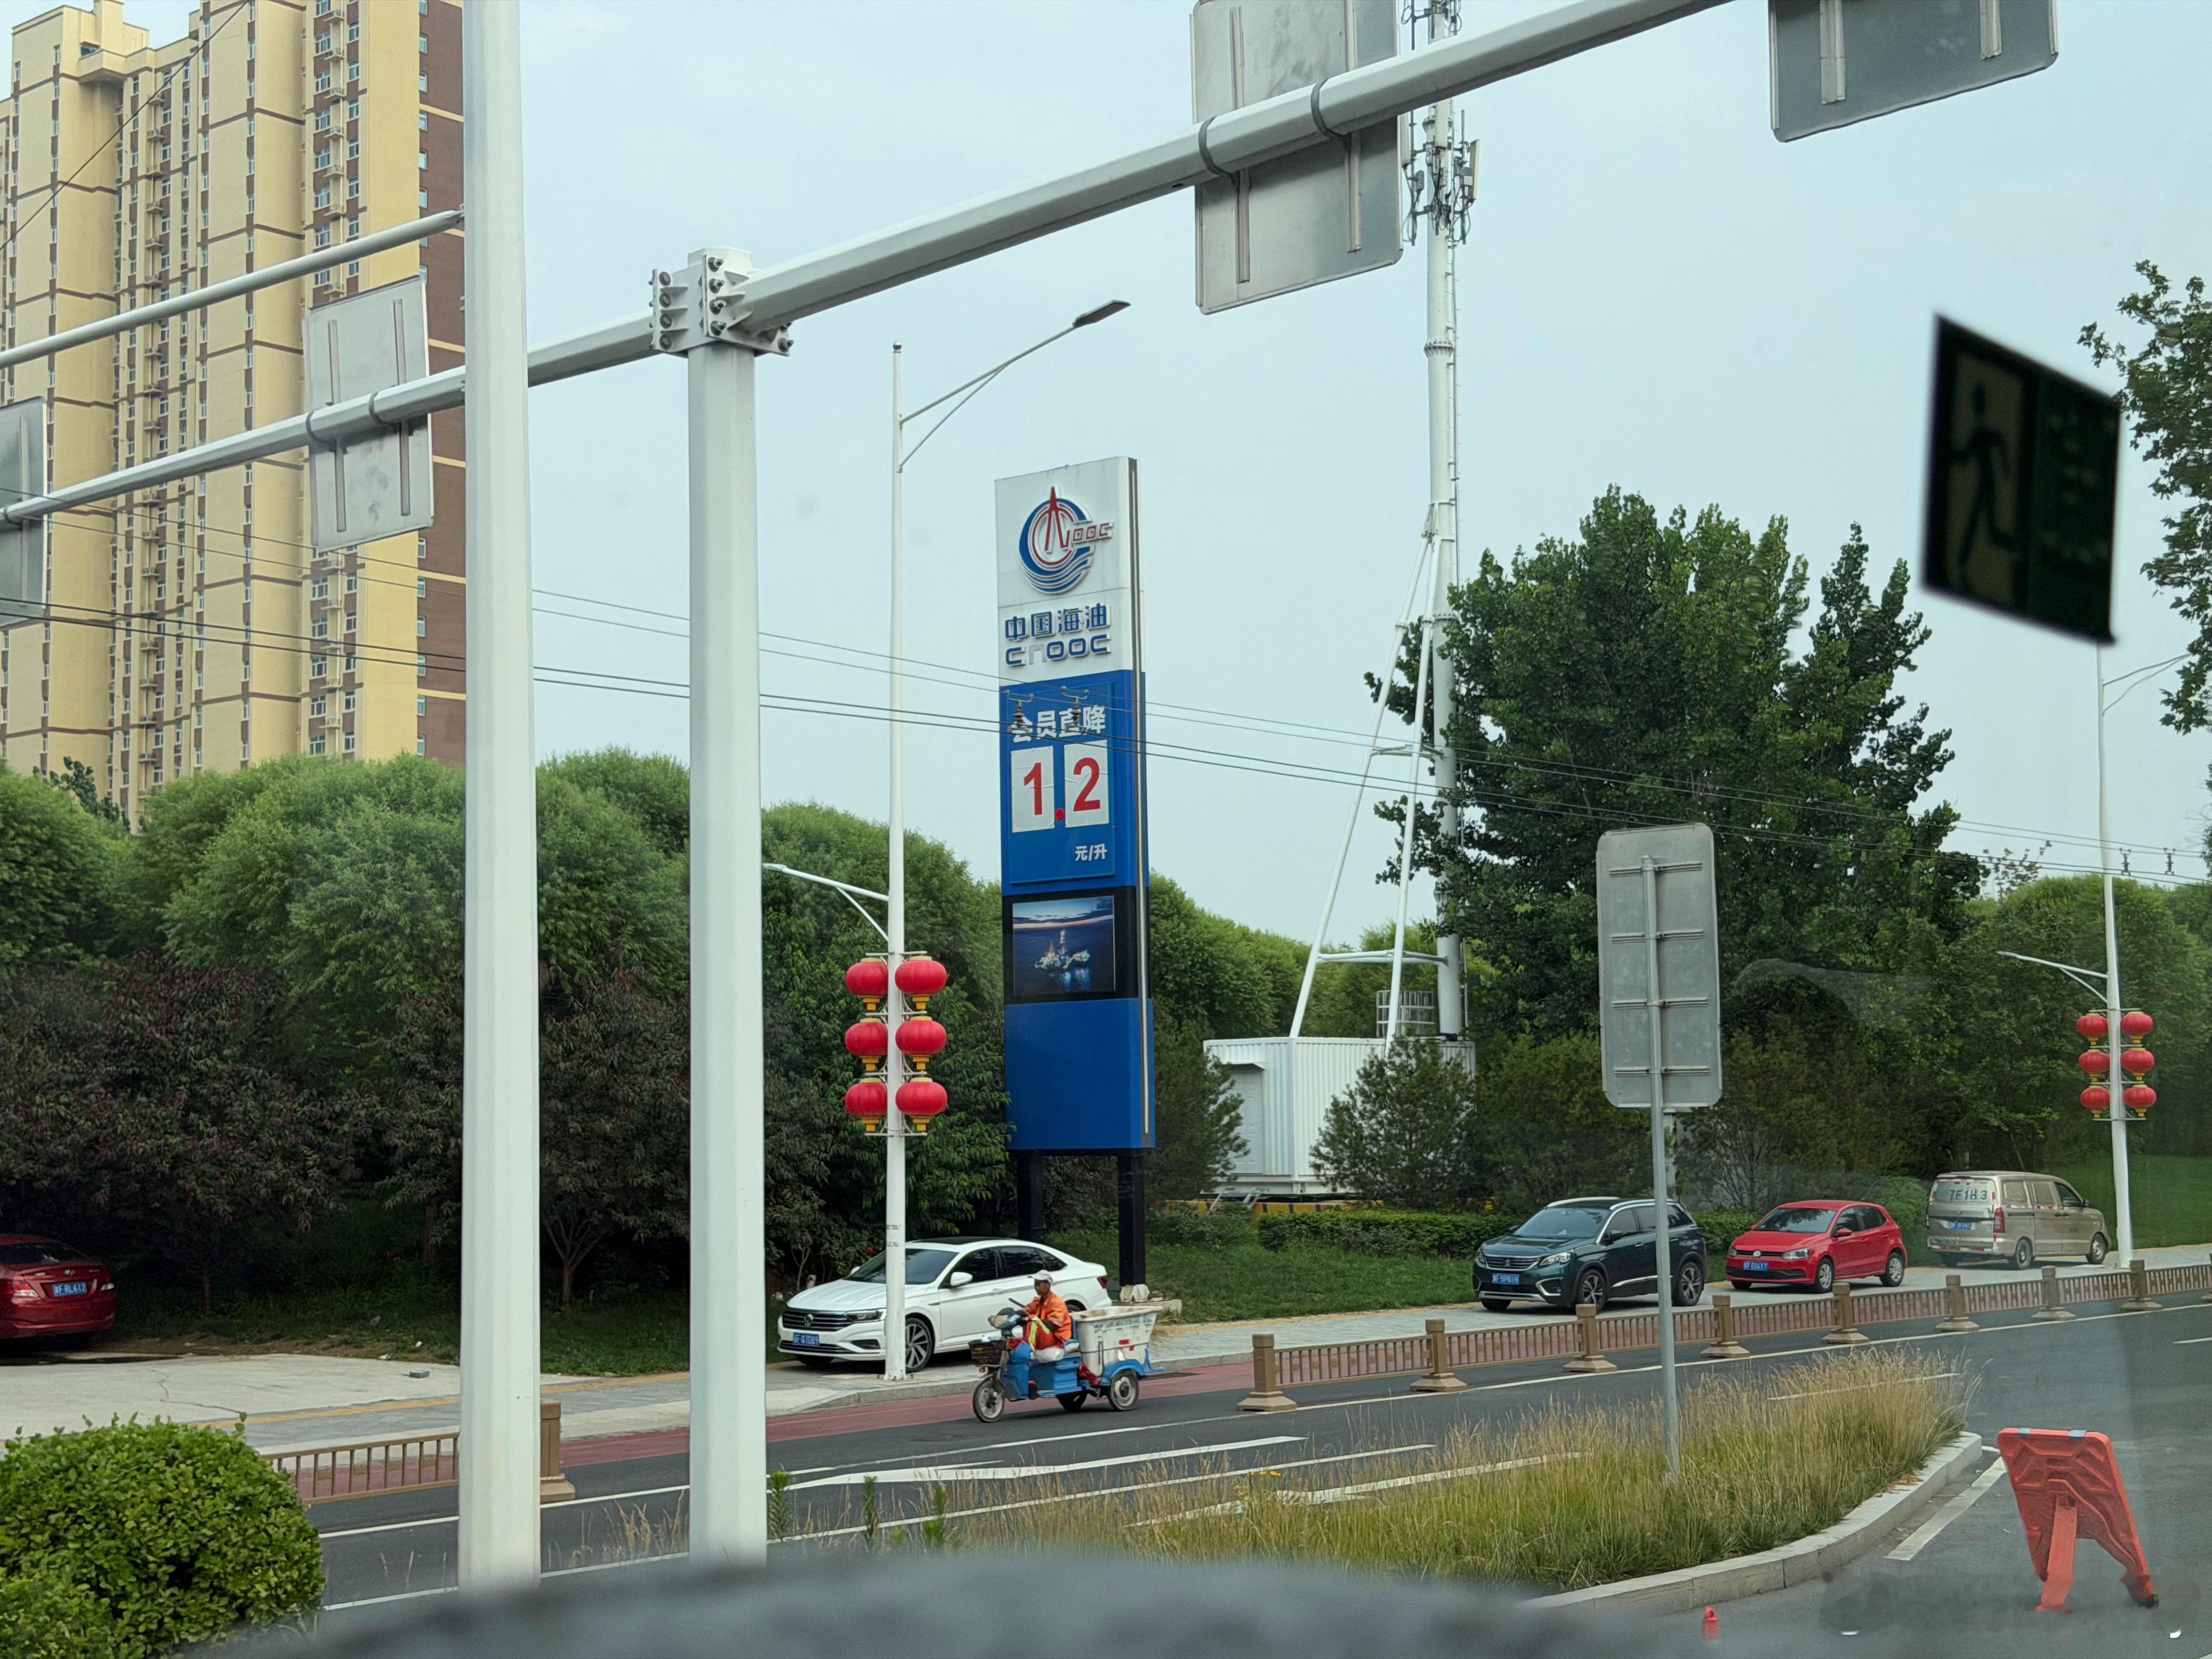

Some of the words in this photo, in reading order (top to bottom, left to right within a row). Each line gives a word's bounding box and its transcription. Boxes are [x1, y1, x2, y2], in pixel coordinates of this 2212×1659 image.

[1005, 603, 1107, 640] 中国海油
[1008, 705, 1106, 743] 会员直降
[1075, 843, 1108, 861] 元/升
